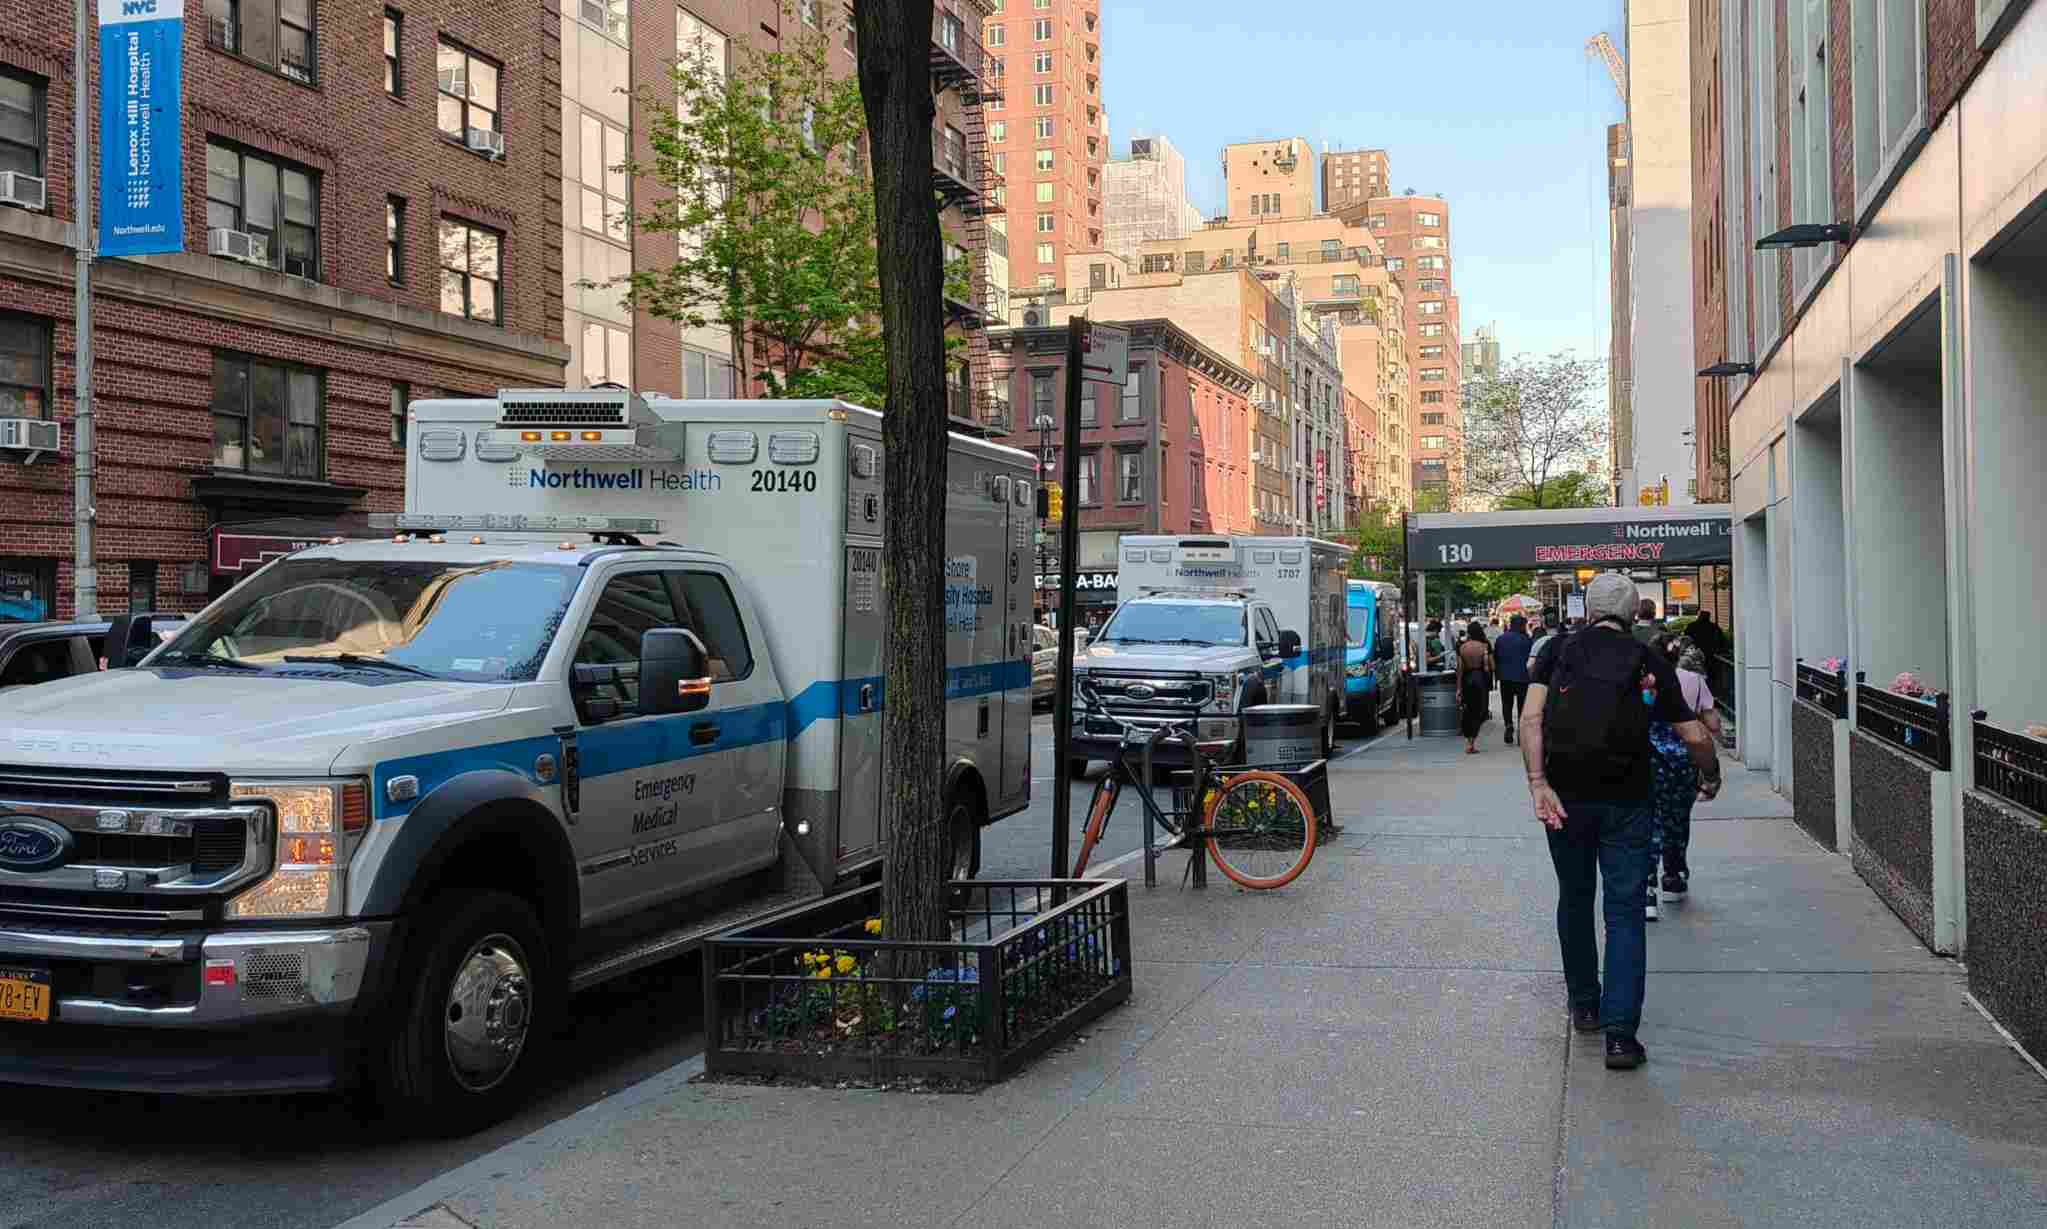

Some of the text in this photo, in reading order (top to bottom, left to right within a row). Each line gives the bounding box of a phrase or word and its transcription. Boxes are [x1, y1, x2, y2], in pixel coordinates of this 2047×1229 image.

[122, 0, 157, 15] NYC
[127, 32, 139, 176] Lenox Hill Hospital
[140, 52, 150, 176] Northwell Health
[530, 468, 720, 490] Northwell Health
[751, 470, 816, 492] 20140
[1626, 522, 1710, 539] Northwell
[851, 550, 877, 573] 20140
[1438, 544, 1473, 563] 130
[1535, 543, 1664, 562] EMERGENCY
[1175, 567, 1226, 579] Northwell
[634, 773, 696, 801] Emergency
[632, 801, 678, 833] Medical
[631, 840, 678, 867] Services
